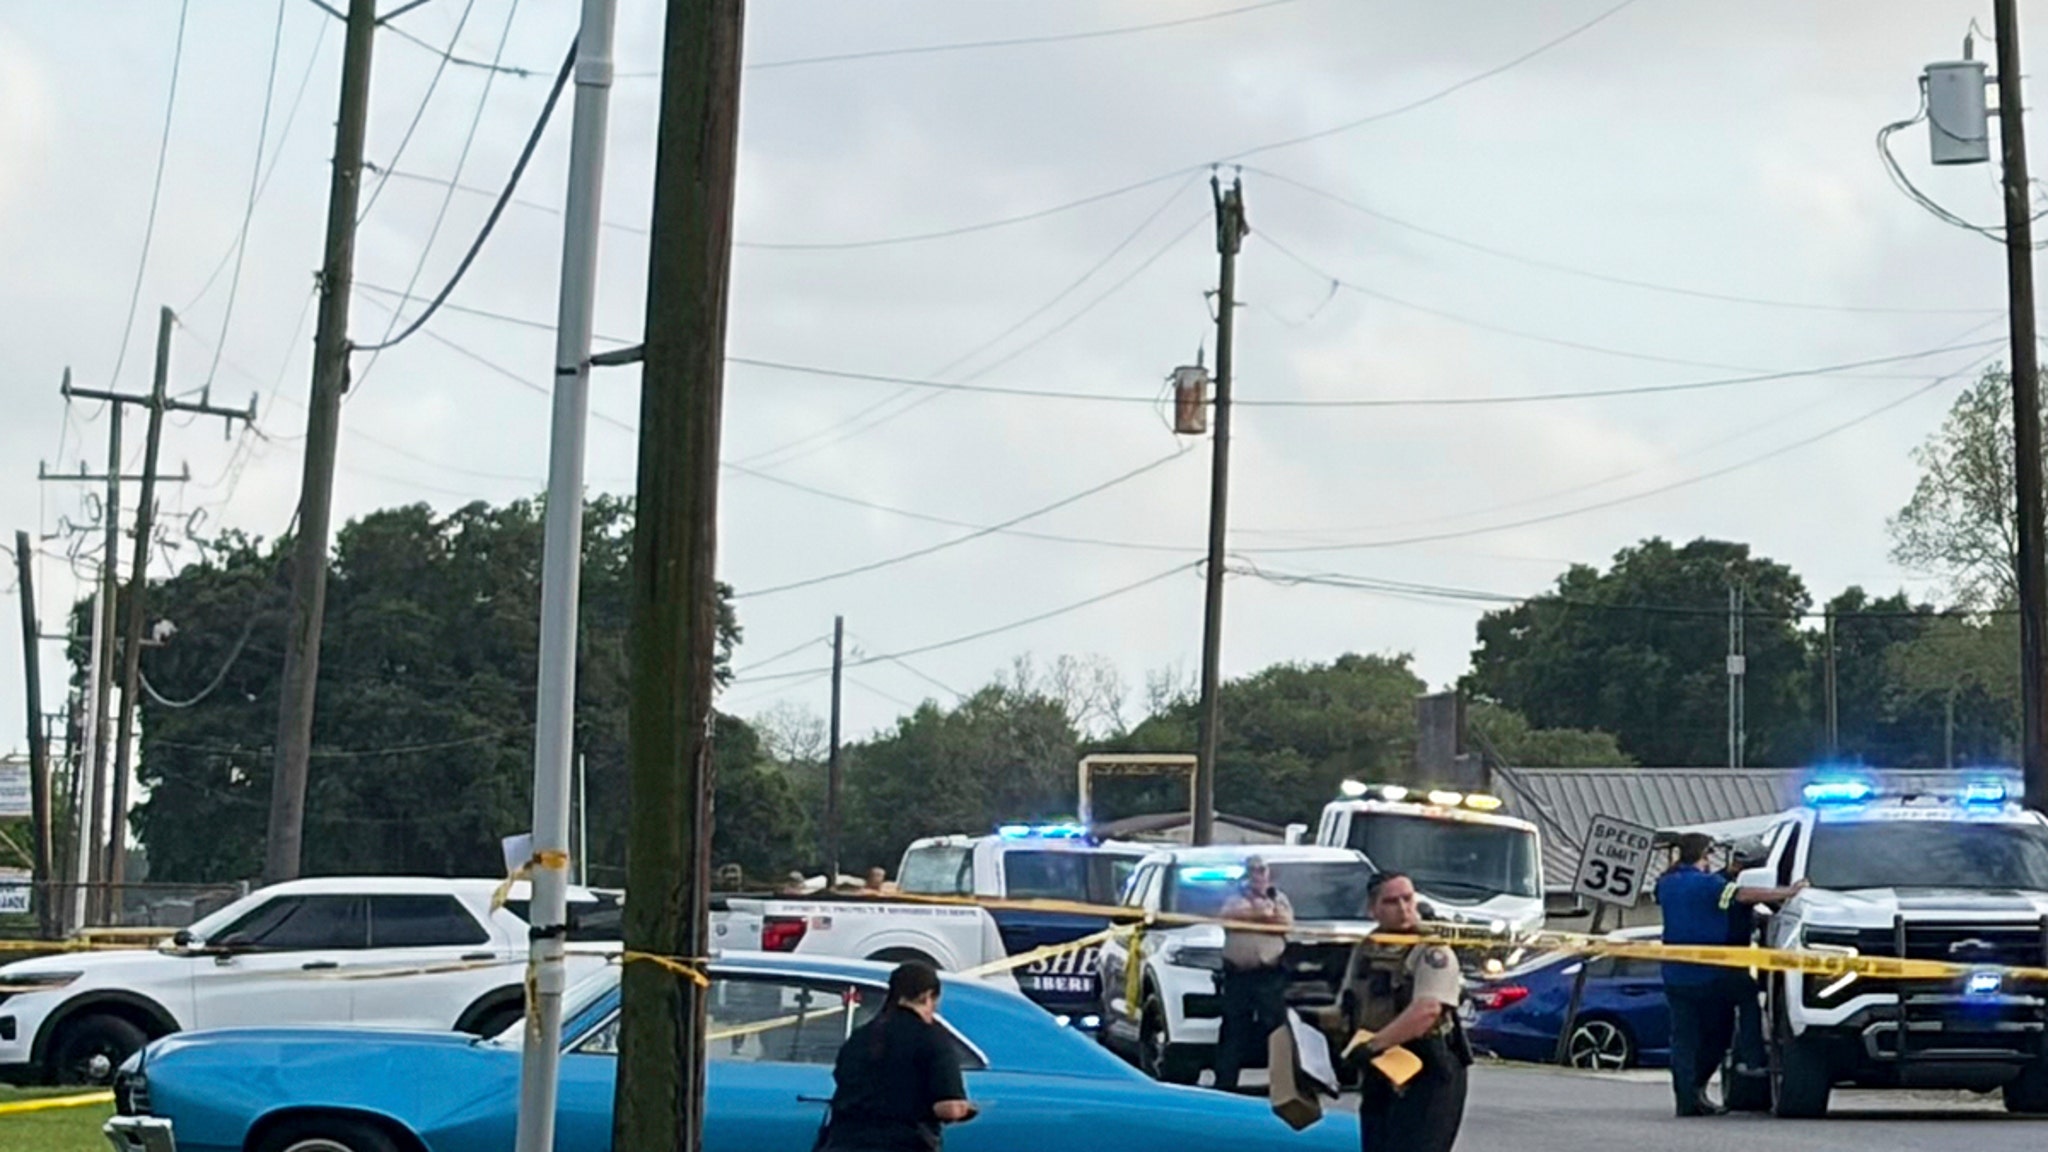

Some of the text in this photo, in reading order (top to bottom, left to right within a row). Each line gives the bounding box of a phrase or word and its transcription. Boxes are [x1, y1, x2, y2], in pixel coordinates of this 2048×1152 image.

[1594, 824, 1649, 849] SPEED
[1596, 841, 1639, 863] LIMIT
[1583, 859, 1635, 896] 35
[1027, 947, 1100, 975] SHE
[1033, 976, 1091, 992] IBERI
